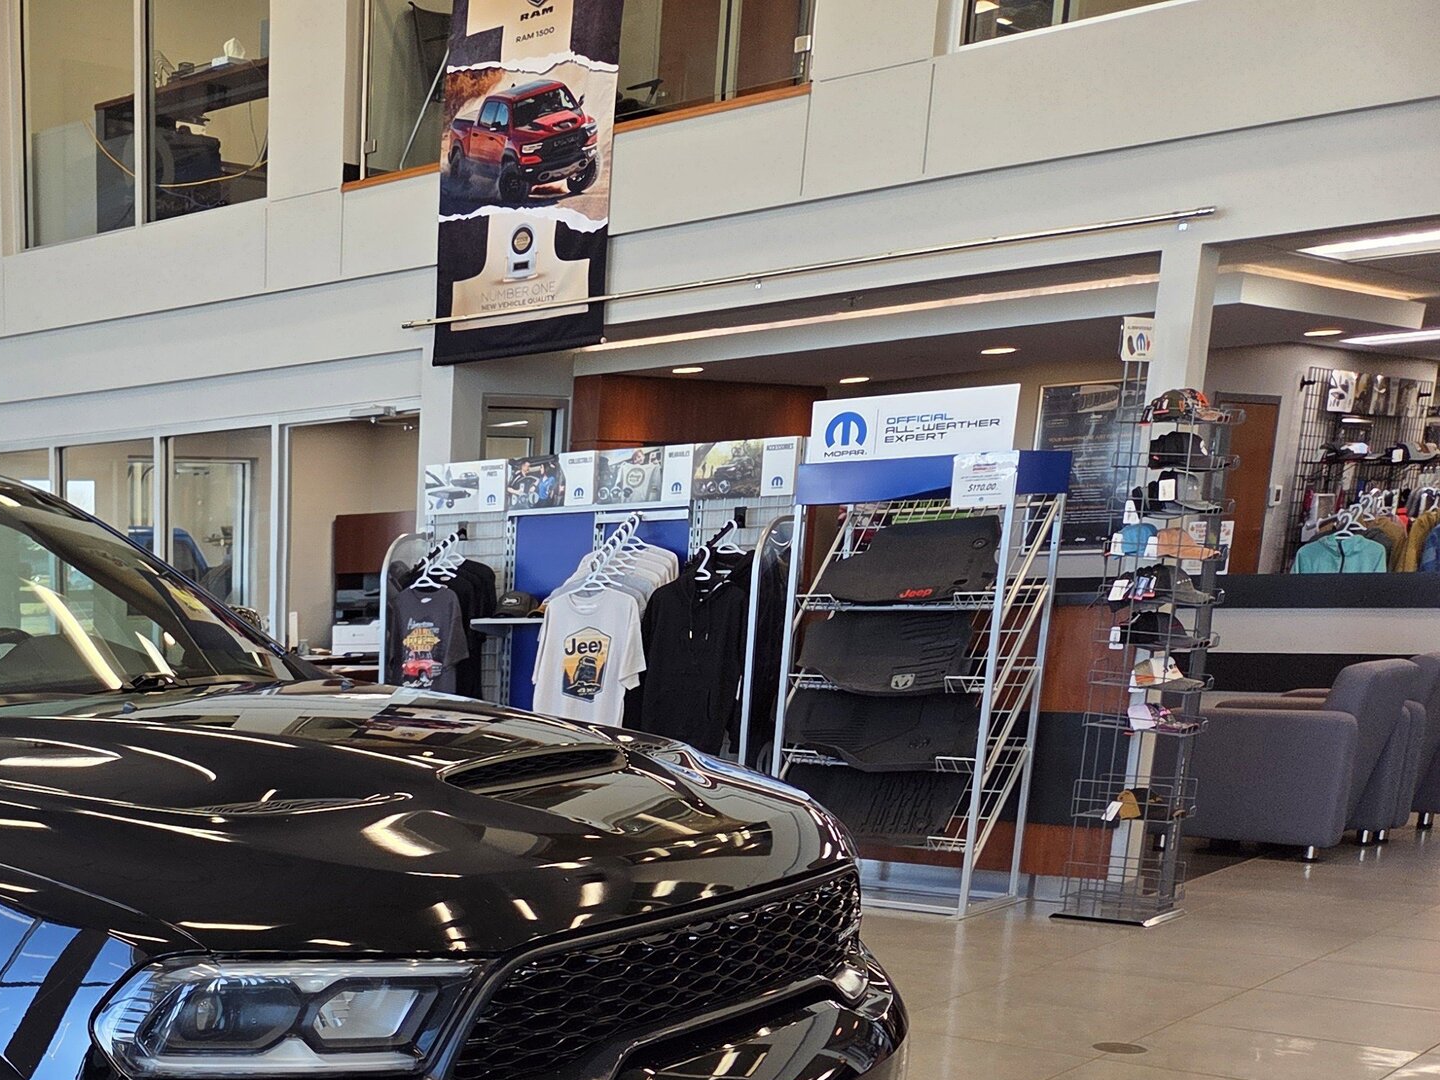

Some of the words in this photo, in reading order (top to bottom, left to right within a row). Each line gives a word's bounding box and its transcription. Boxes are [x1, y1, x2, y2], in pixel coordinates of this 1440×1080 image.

[520, 6, 554, 21] RAM
[516, 32, 535, 43] RAM
[536, 26, 555, 38] 1500
[481, 285, 529, 302] NUMBER
[531, 281, 557, 294] ONE
[498, 300, 527, 309] VEHICLE
[528, 294, 556, 304] QUALITY
[886, 413, 954, 425] OFFICIAL
[885, 418, 1001, 434] ALL-WEATHER
[884, 432, 947, 444] EXPERT
[823, 449, 866, 458] MOPAR
[967, 482, 997, 492] $170.00
[899, 587, 933, 599] Jeep
